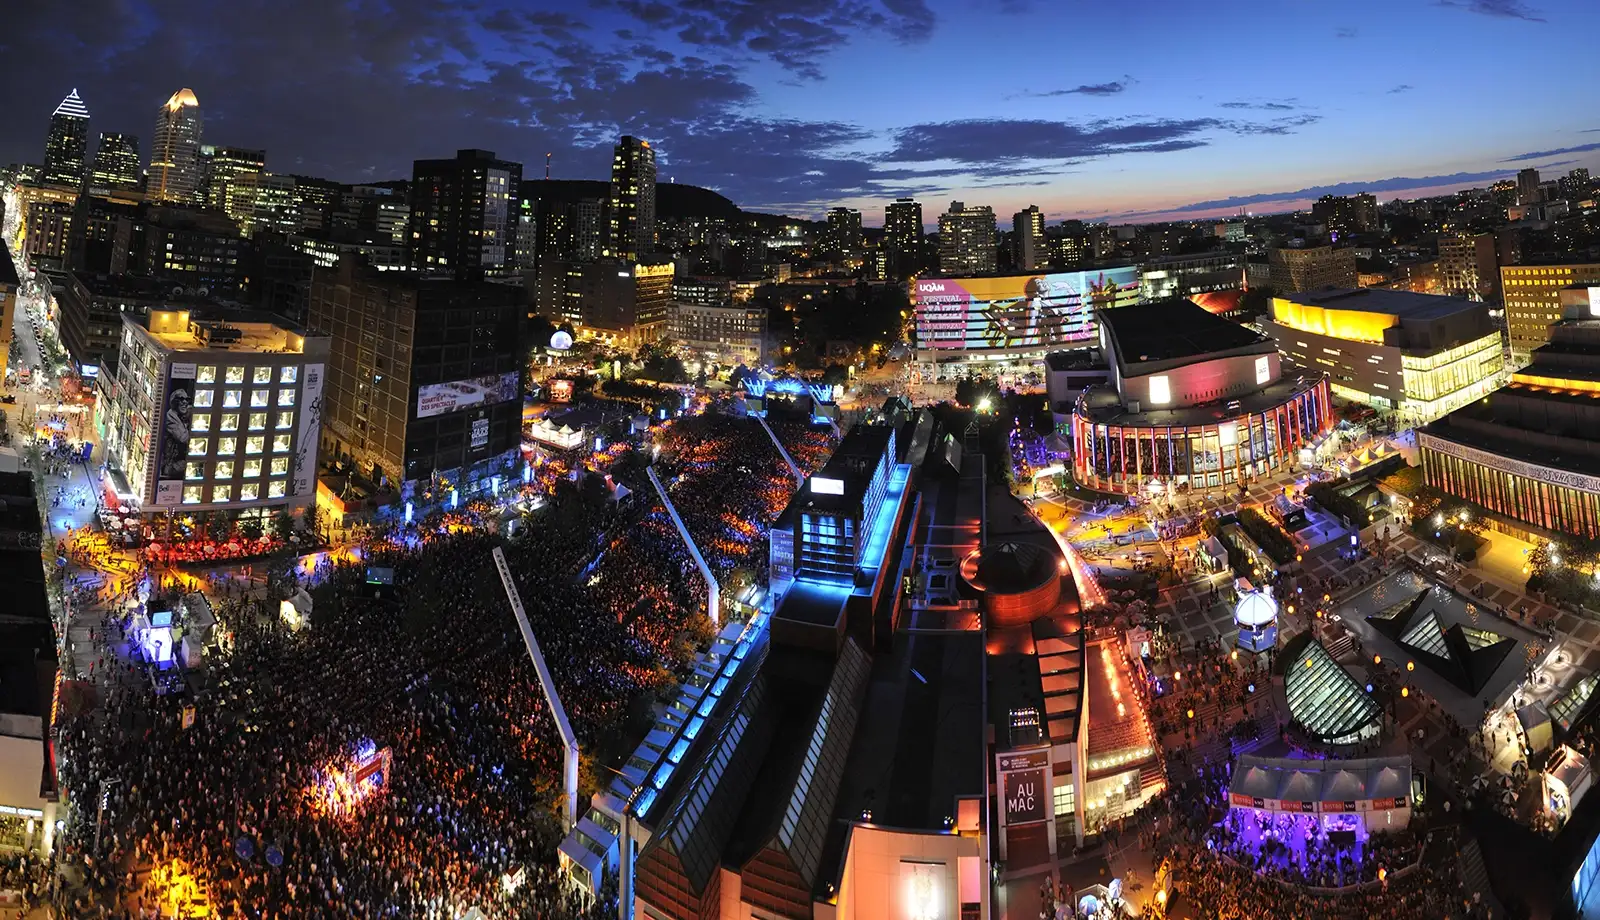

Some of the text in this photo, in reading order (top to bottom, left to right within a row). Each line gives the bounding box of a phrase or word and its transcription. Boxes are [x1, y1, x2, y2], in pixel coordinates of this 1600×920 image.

[923, 295, 962, 303] FESTIVAL
[924, 305, 962, 319] JAZZ
[421, 396, 444, 404] QUARTIER
[430, 400, 456, 410] SPECTACLES
[1431, 440, 1464, 456] FESTIVAL
[1542, 468, 1568, 484] JAZZ
[1568, 474, 1585, 488] DE
[1018, 783, 1034, 797] AU
[1009, 797, 1034, 812] MAC
[1234, 796, 1251, 804] BISTRO
